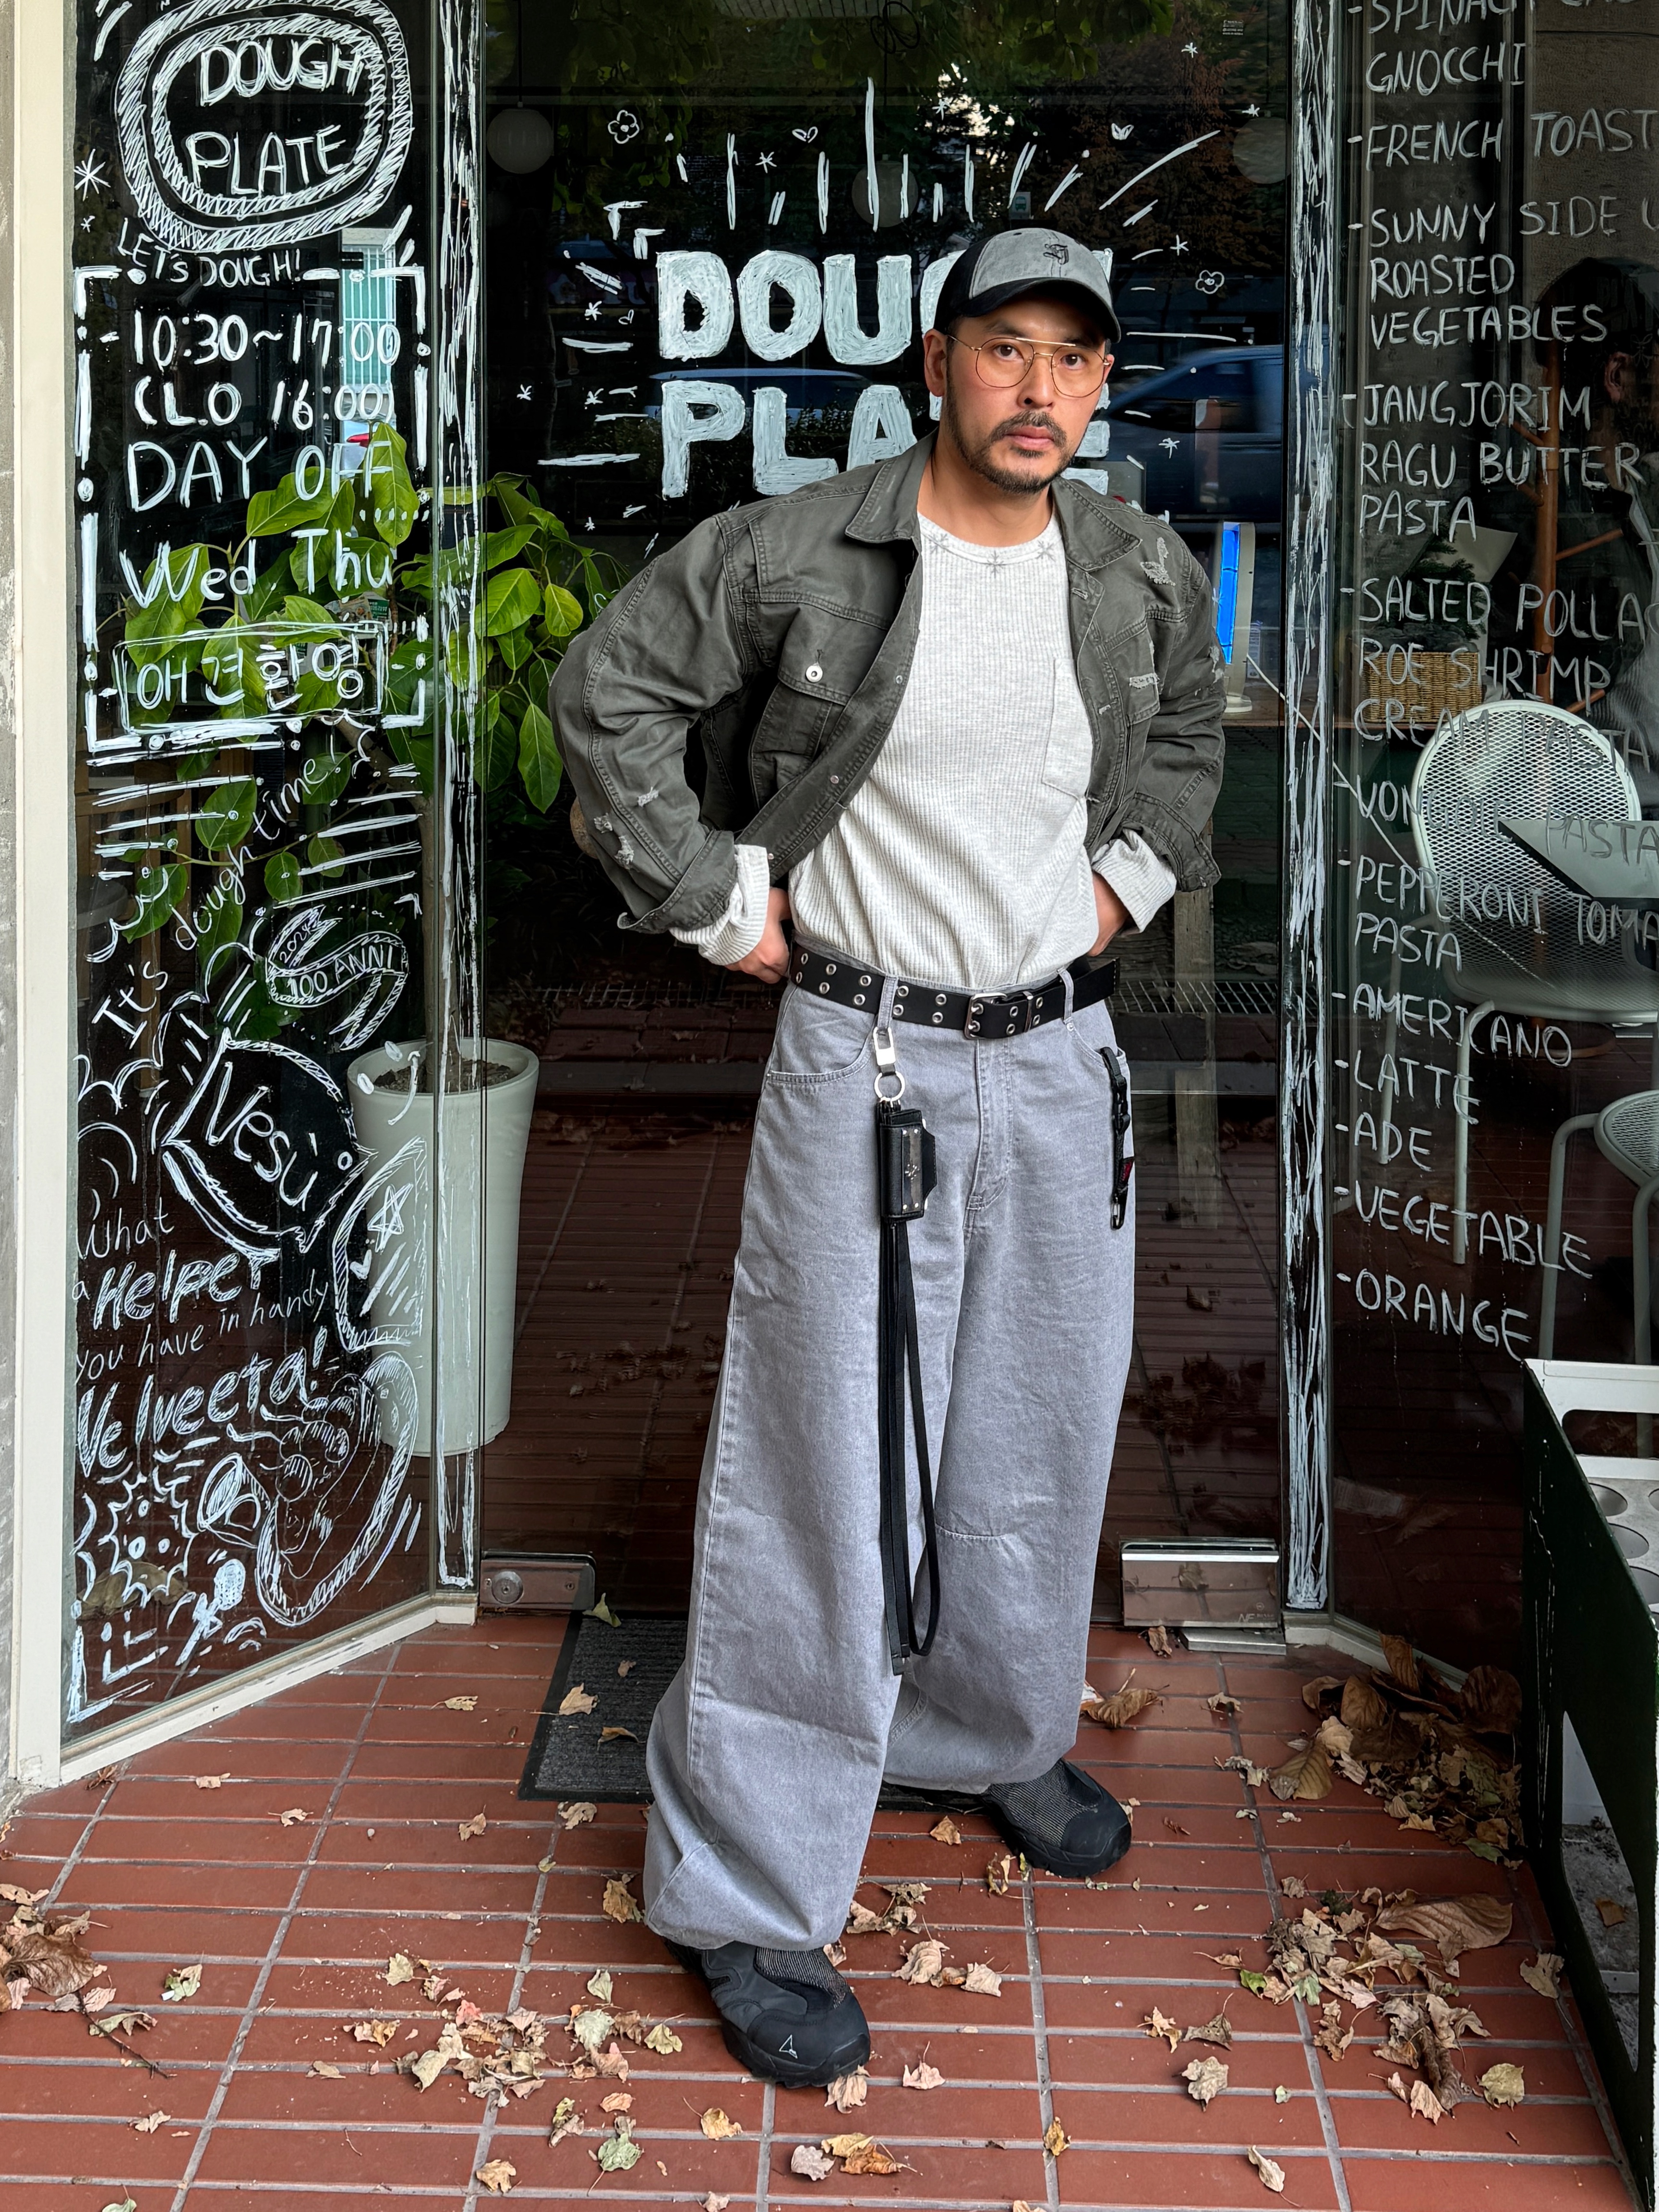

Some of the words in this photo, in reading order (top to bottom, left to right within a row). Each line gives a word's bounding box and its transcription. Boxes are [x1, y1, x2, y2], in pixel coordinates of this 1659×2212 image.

[199, 38, 364, 107] DOUGH
[1365, 41, 1527, 96] GNOCCHI
[186, 124, 347, 195] PLATE
[1530, 108, 1659, 161] TOAST
[1519, 195, 1622, 238] SIDE
[197, 248, 301, 288] DOUGH!
[1370, 253, 1515, 303] ROASTED
[656, 249, 1113, 366] DOU
[1370, 303, 1608, 350] VEGETABLES
[661, 379, 1110, 500] PLA
[1360, 440, 1456, 489] RAGU
[1479, 442, 1647, 491] BUTTER
[127, 436, 269, 512] DAY
[295, 440, 394, 501] OFF
[1359, 490, 1478, 543] PASTA
[119, 539, 257, 609] Wed
[290, 528, 394, 596] Thu
[1359, 637, 1425, 686] ROE
[1450, 646, 1612, 717] SHRIMP
[1354, 698, 1490, 754] CREAM
[1521, 711, 1651, 774] PASTA
[169, 843, 257, 951] dough
[252, 757, 330, 841] time
[1546, 805, 1659, 866] PASTA
[1354, 912, 1462, 972] PASTA
[286, 970, 328, 999] 100
[138, 1323, 204, 1368] have
[219, 1308, 240, 1336] in
[249, 1268, 329, 1328] handy
